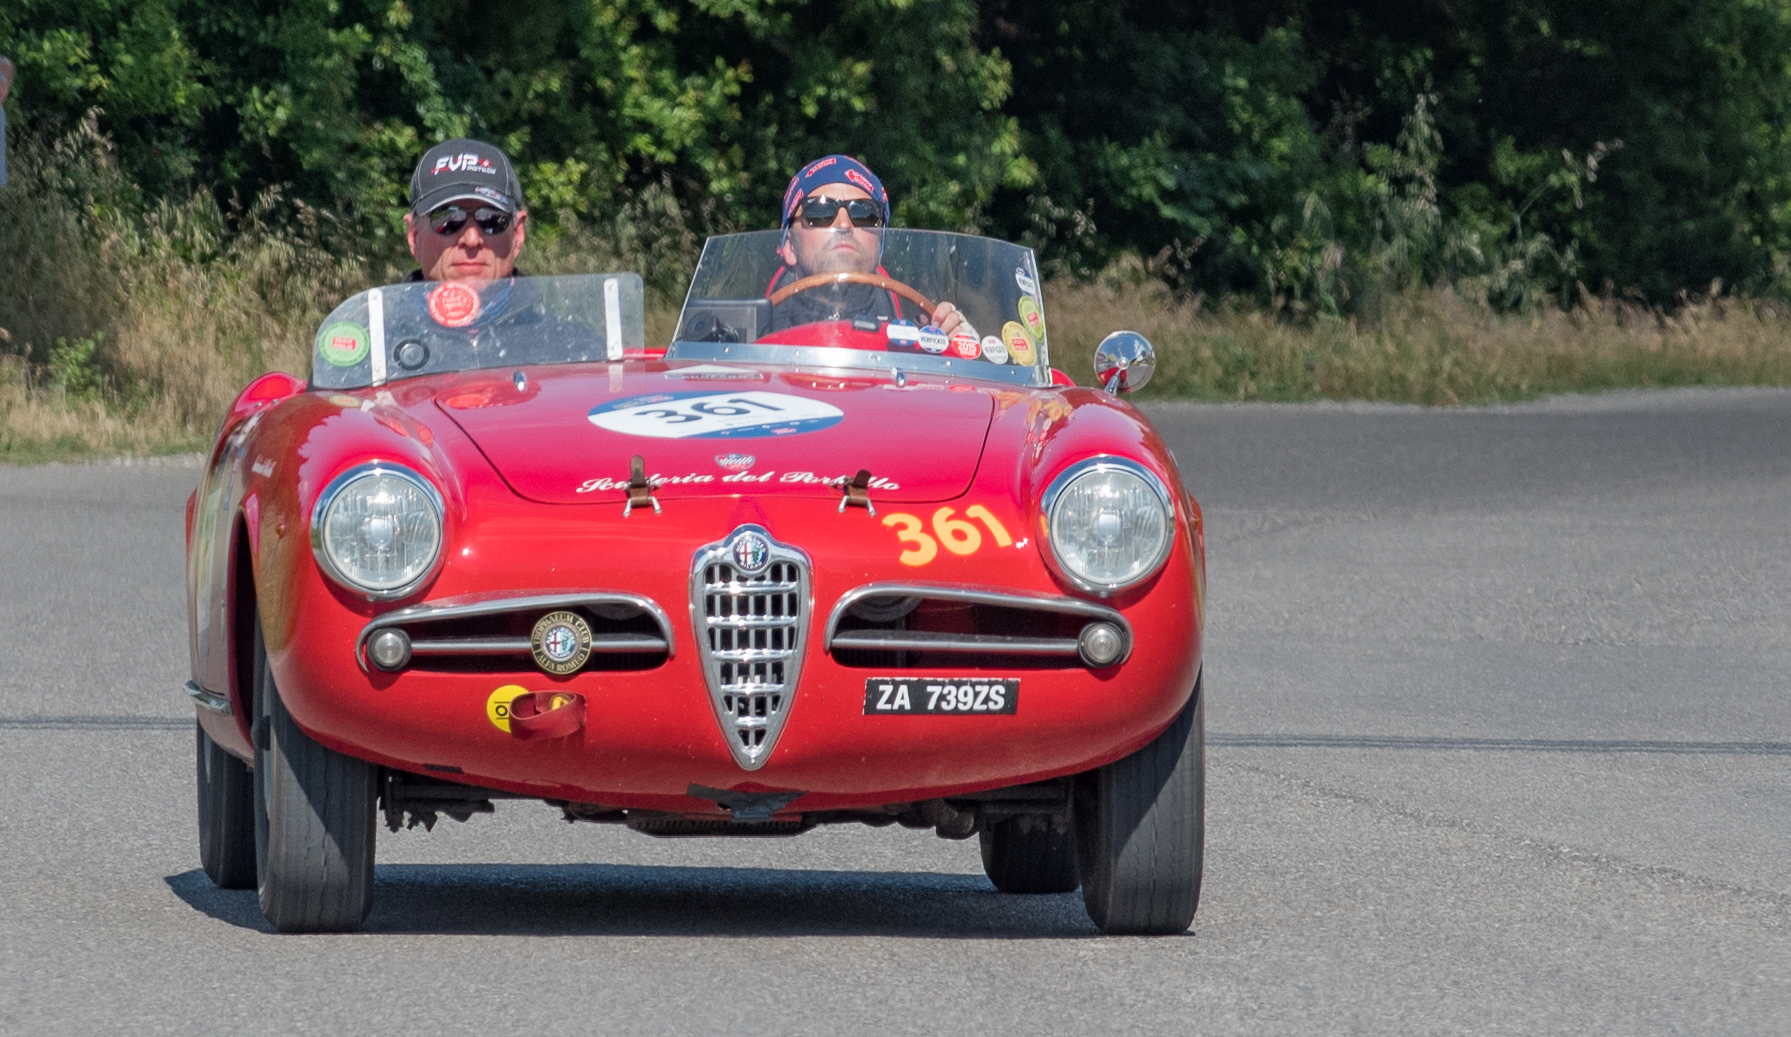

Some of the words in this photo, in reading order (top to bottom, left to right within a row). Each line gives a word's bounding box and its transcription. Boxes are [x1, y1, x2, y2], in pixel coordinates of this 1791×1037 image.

[434, 153, 479, 175] FVP
[632, 398, 786, 424] 361
[722, 471, 775, 482] del
[779, 472, 899, 490] Portllo
[882, 504, 1012, 567] 361
[575, 619, 590, 644] CLUB
[537, 655, 555, 671] ALFA
[556, 653, 585, 672] ROMEO
[876, 684, 911, 711] ZA
[926, 684, 1006, 711] 739ZS
